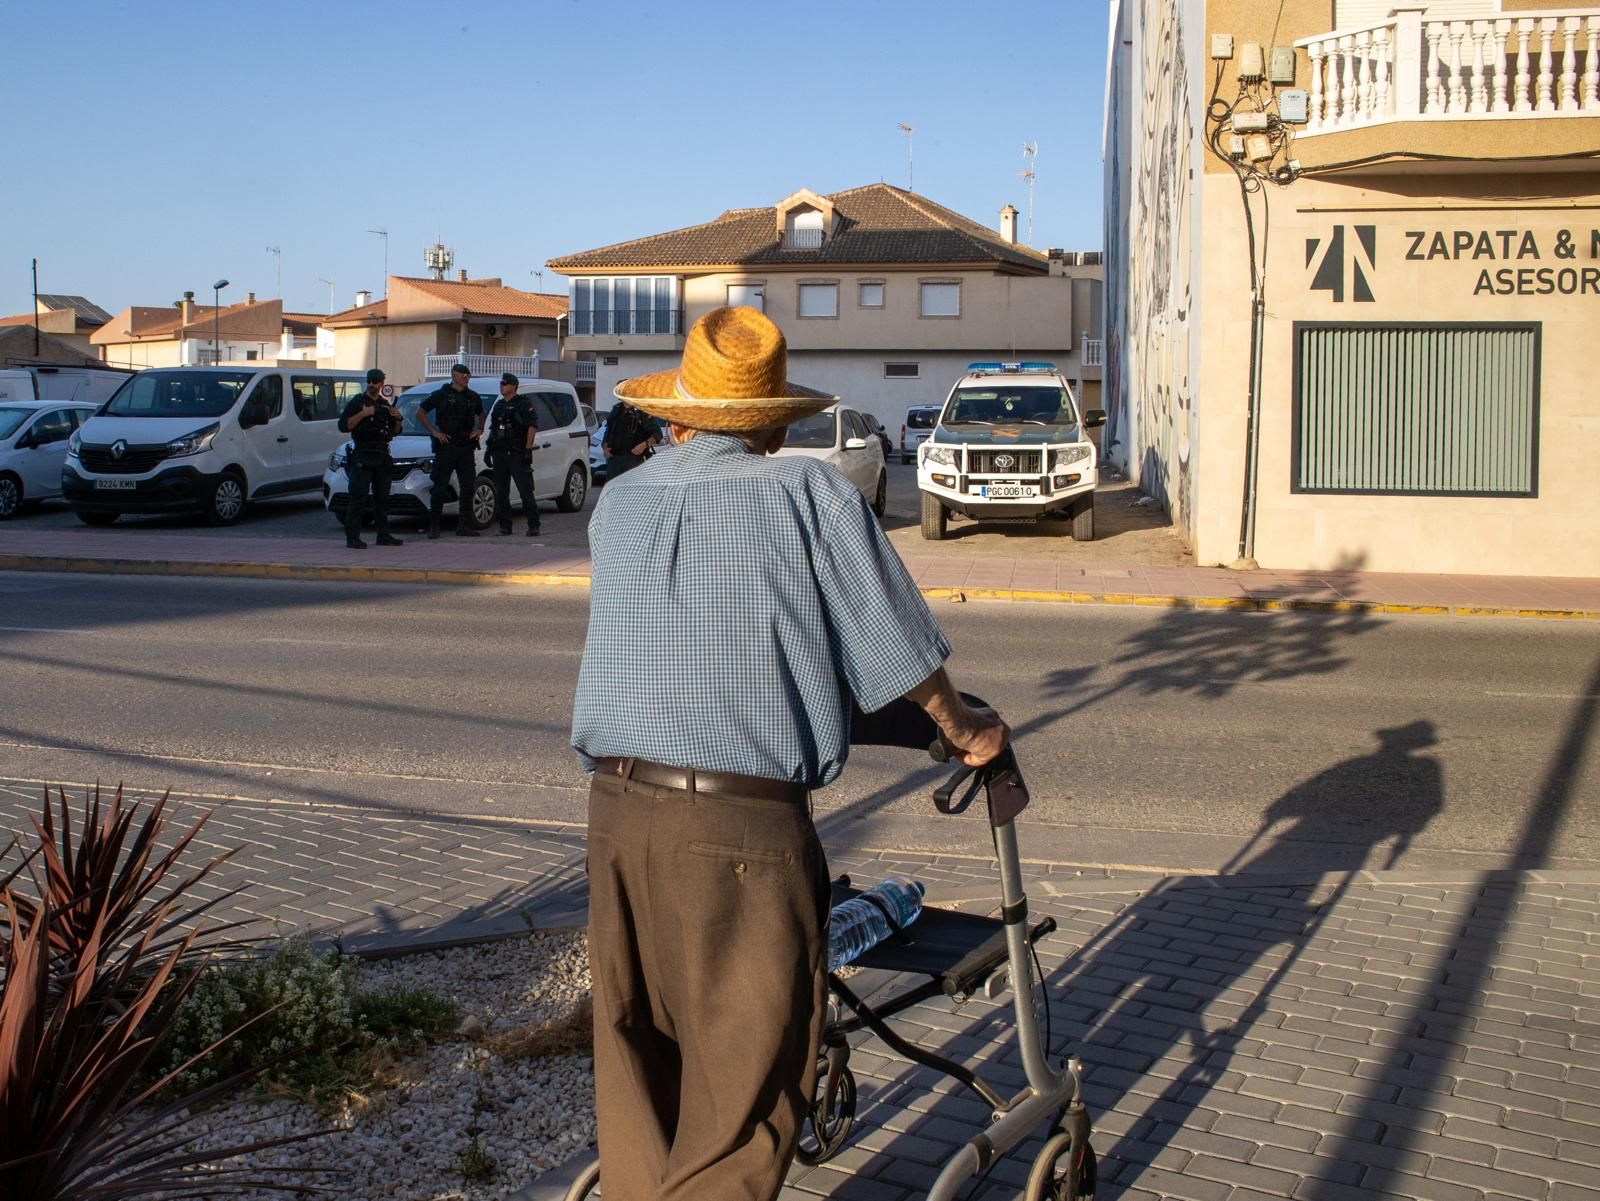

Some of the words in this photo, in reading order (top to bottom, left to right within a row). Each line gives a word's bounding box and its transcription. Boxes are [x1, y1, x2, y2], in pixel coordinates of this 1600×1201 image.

[1405, 230, 1540, 260] ZAPATA
[1554, 229, 1576, 259] &
[986, 487, 1002, 495] PGC
